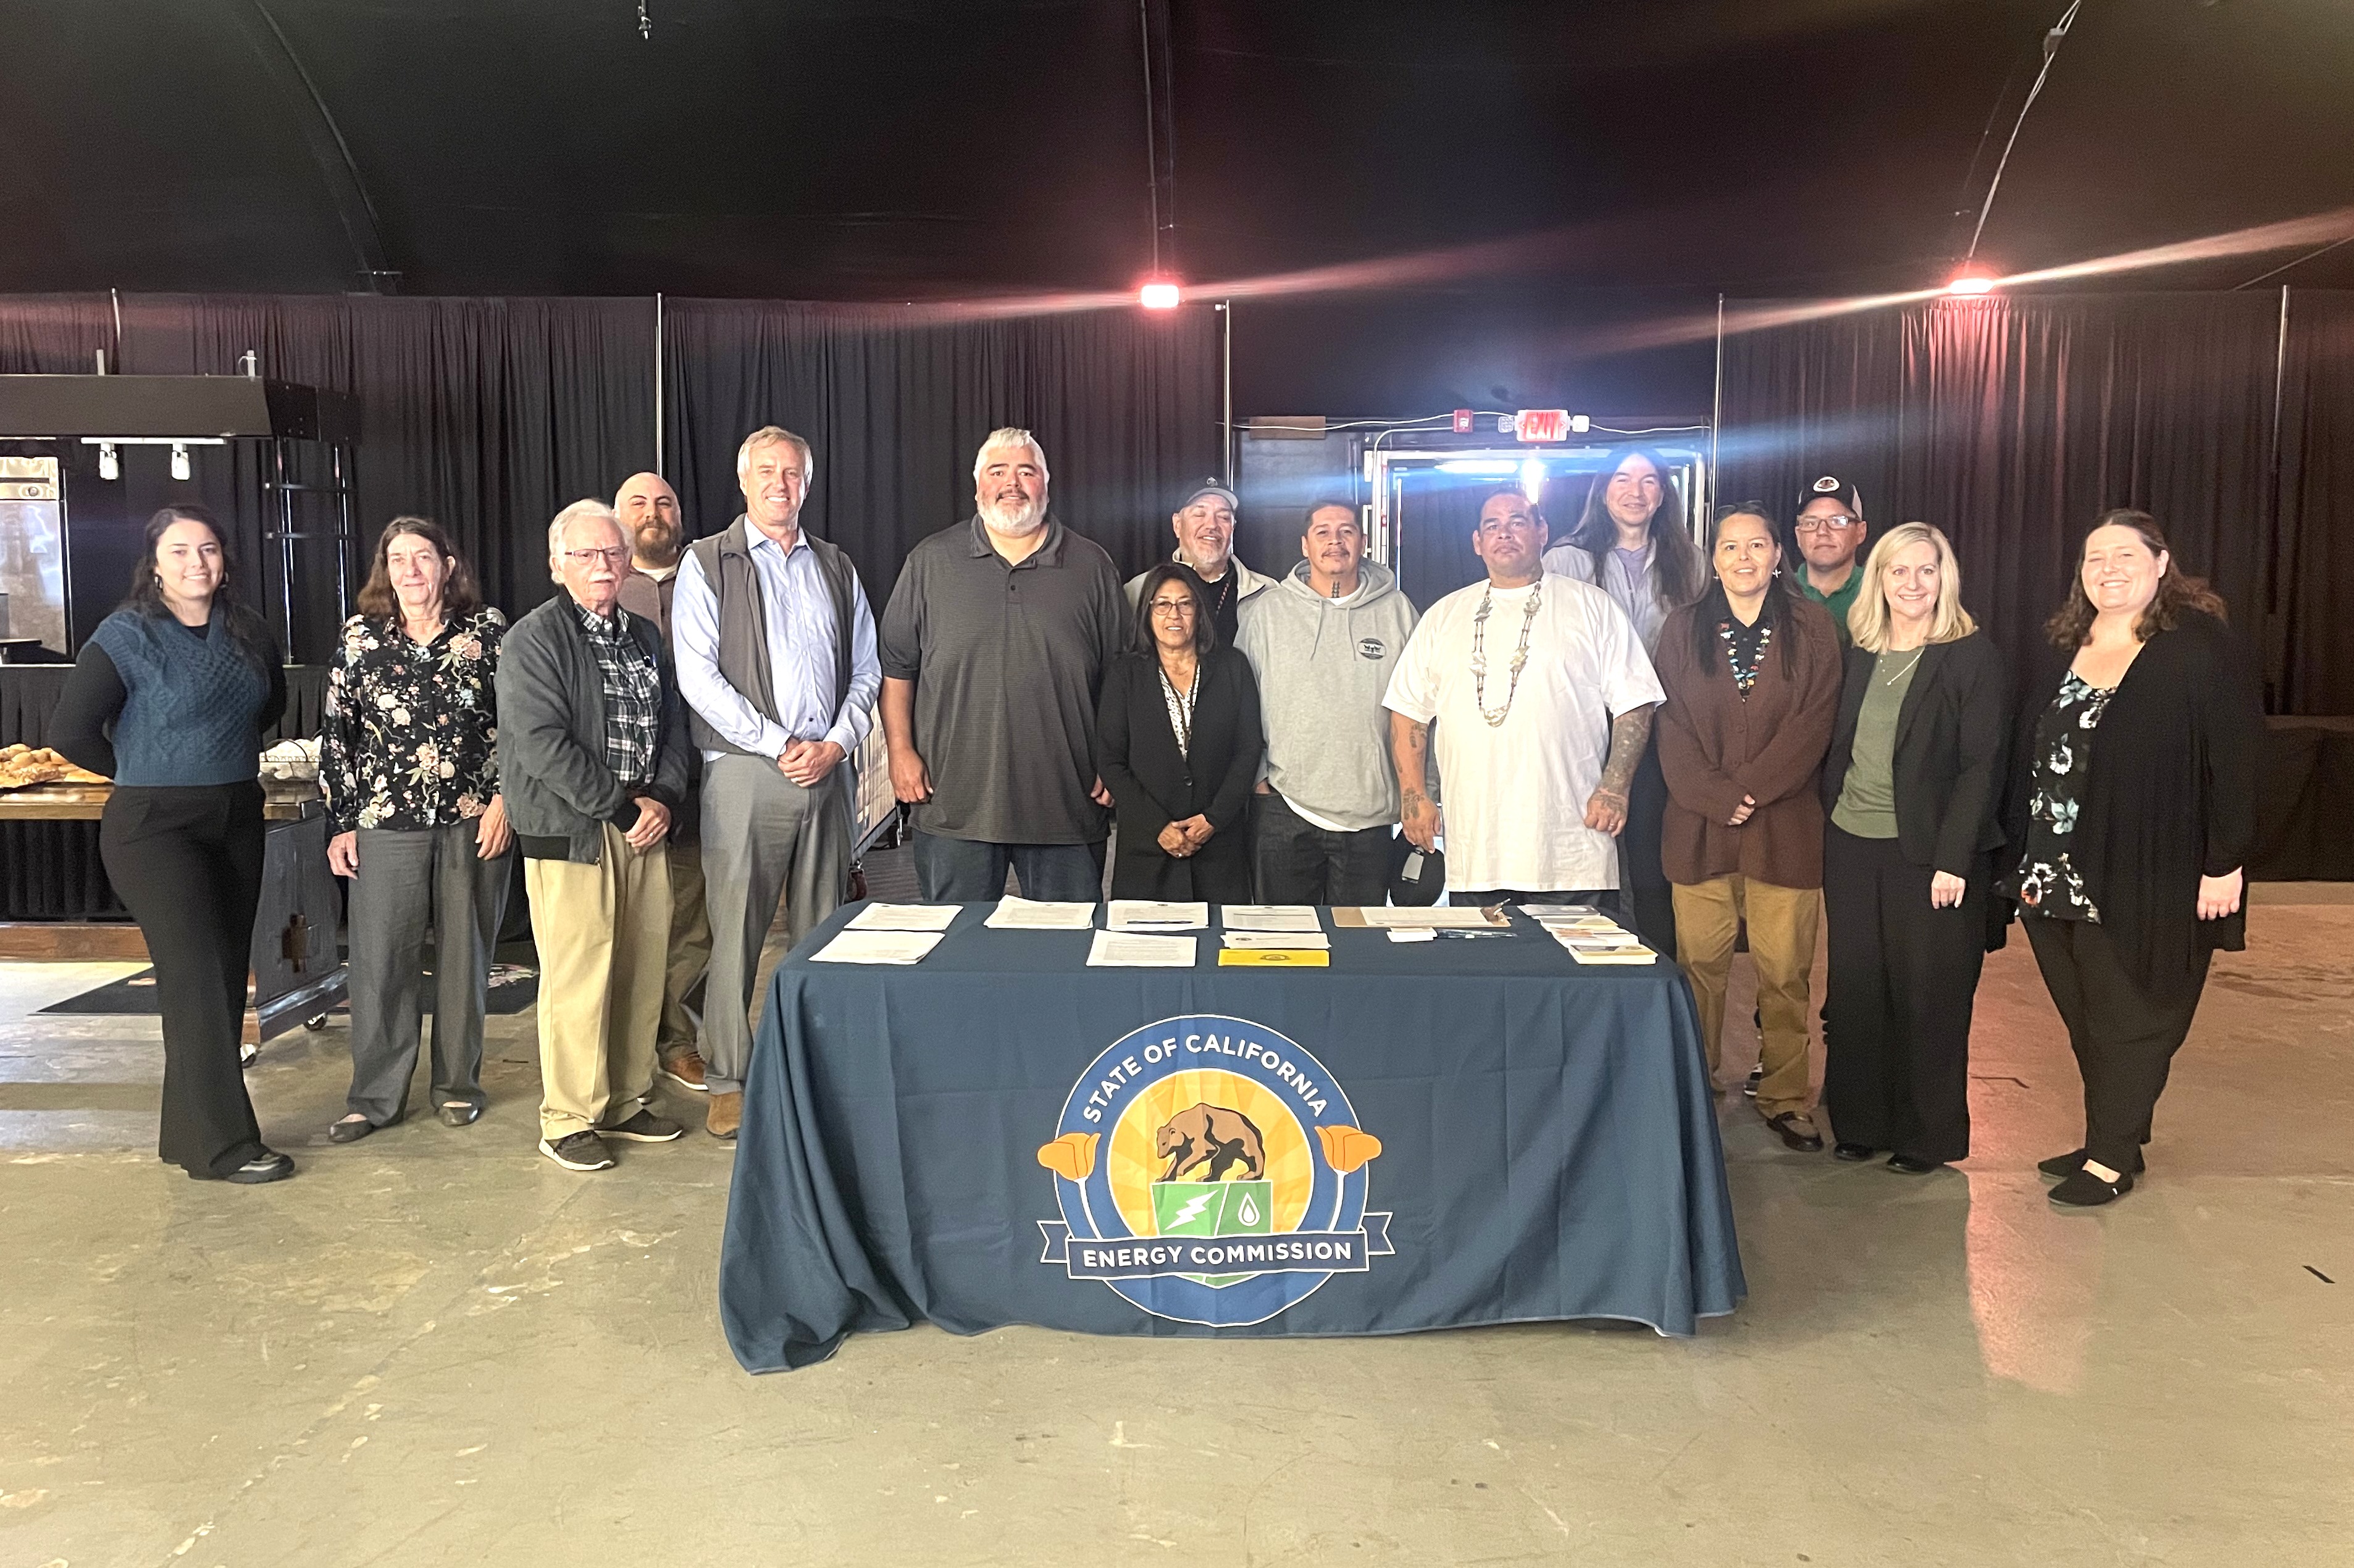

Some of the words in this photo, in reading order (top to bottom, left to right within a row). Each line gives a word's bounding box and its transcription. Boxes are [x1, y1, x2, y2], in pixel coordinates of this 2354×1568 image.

[1525, 411, 1560, 439] EXIT
[1083, 1055, 1143, 1124] STATE
[1144, 1038, 1178, 1064] OF
[1184, 1033, 1328, 1118] CALIFORNIA
[1083, 1245, 1183, 1268] ENERGY
[1190, 1241, 1352, 1265] COMMISSION
